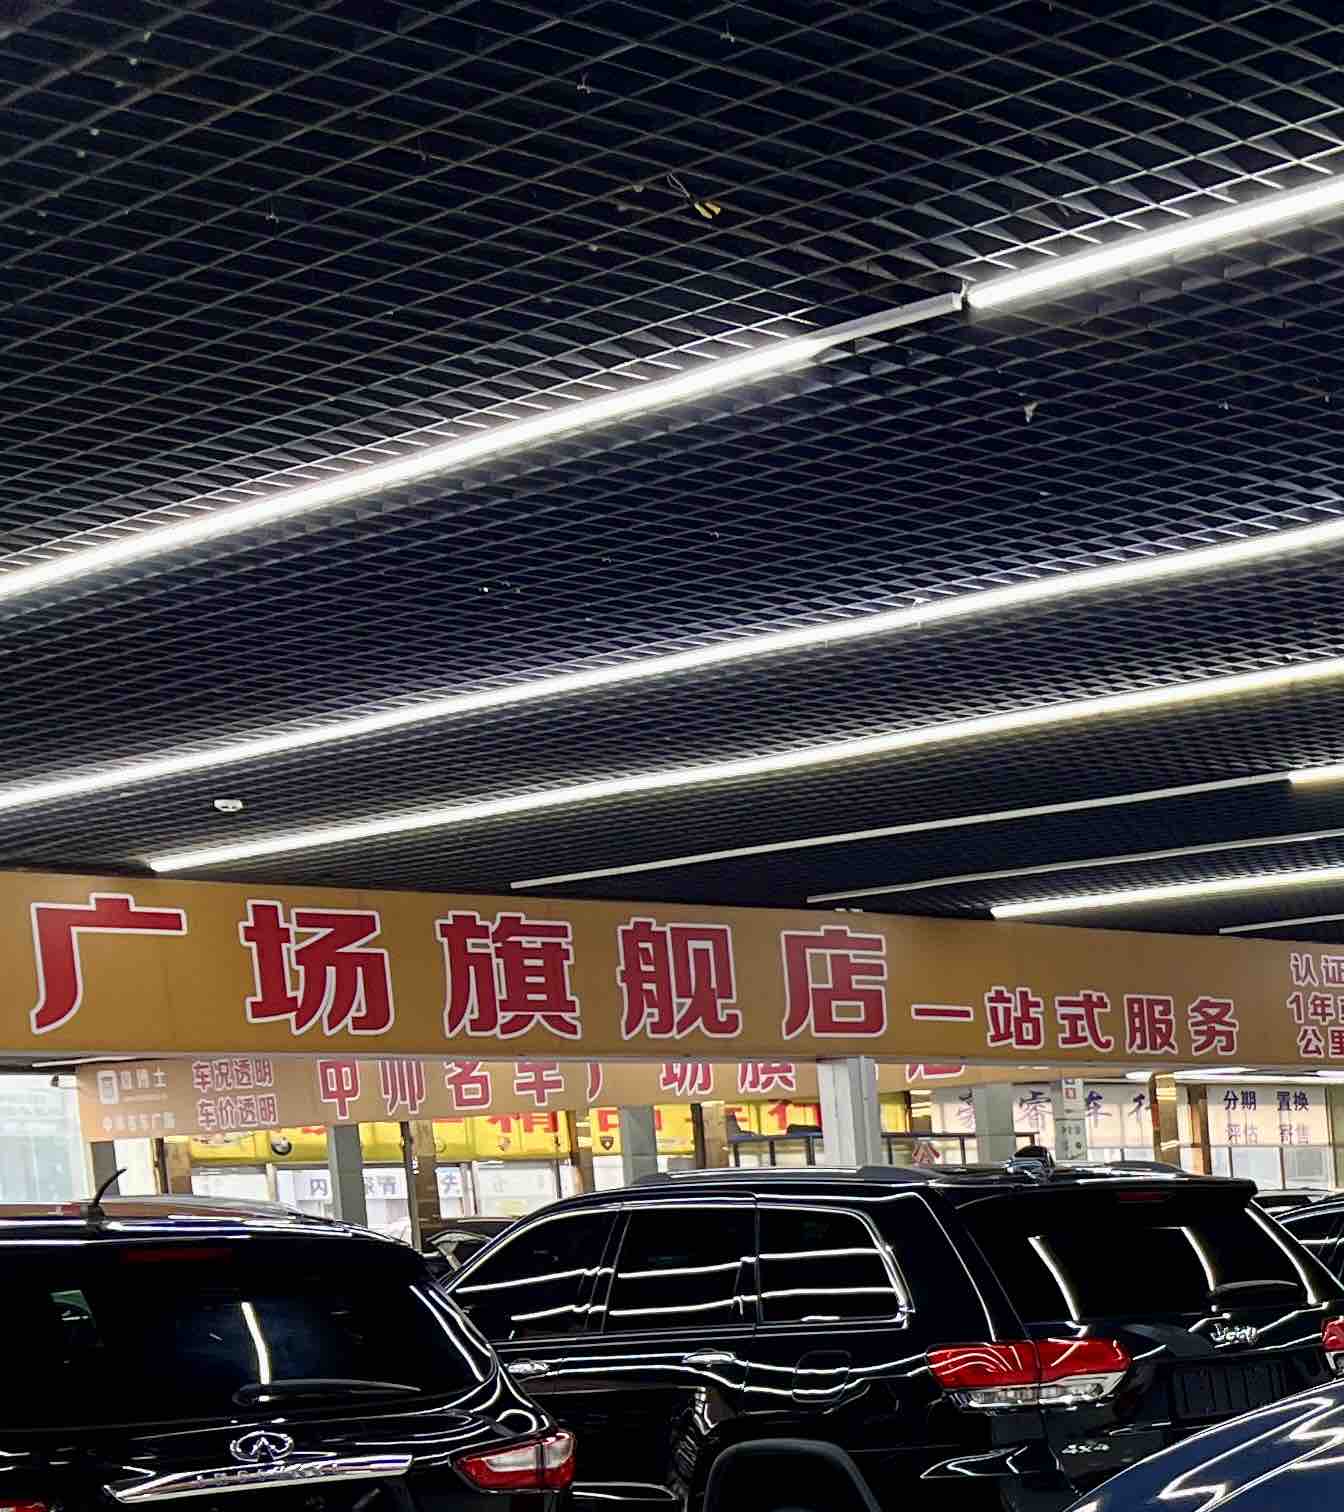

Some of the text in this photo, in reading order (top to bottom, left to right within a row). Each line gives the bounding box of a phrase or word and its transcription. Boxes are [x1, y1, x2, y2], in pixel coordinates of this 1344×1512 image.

[30, 893, 1240, 1056] 广场旗舰店 一站式服务
